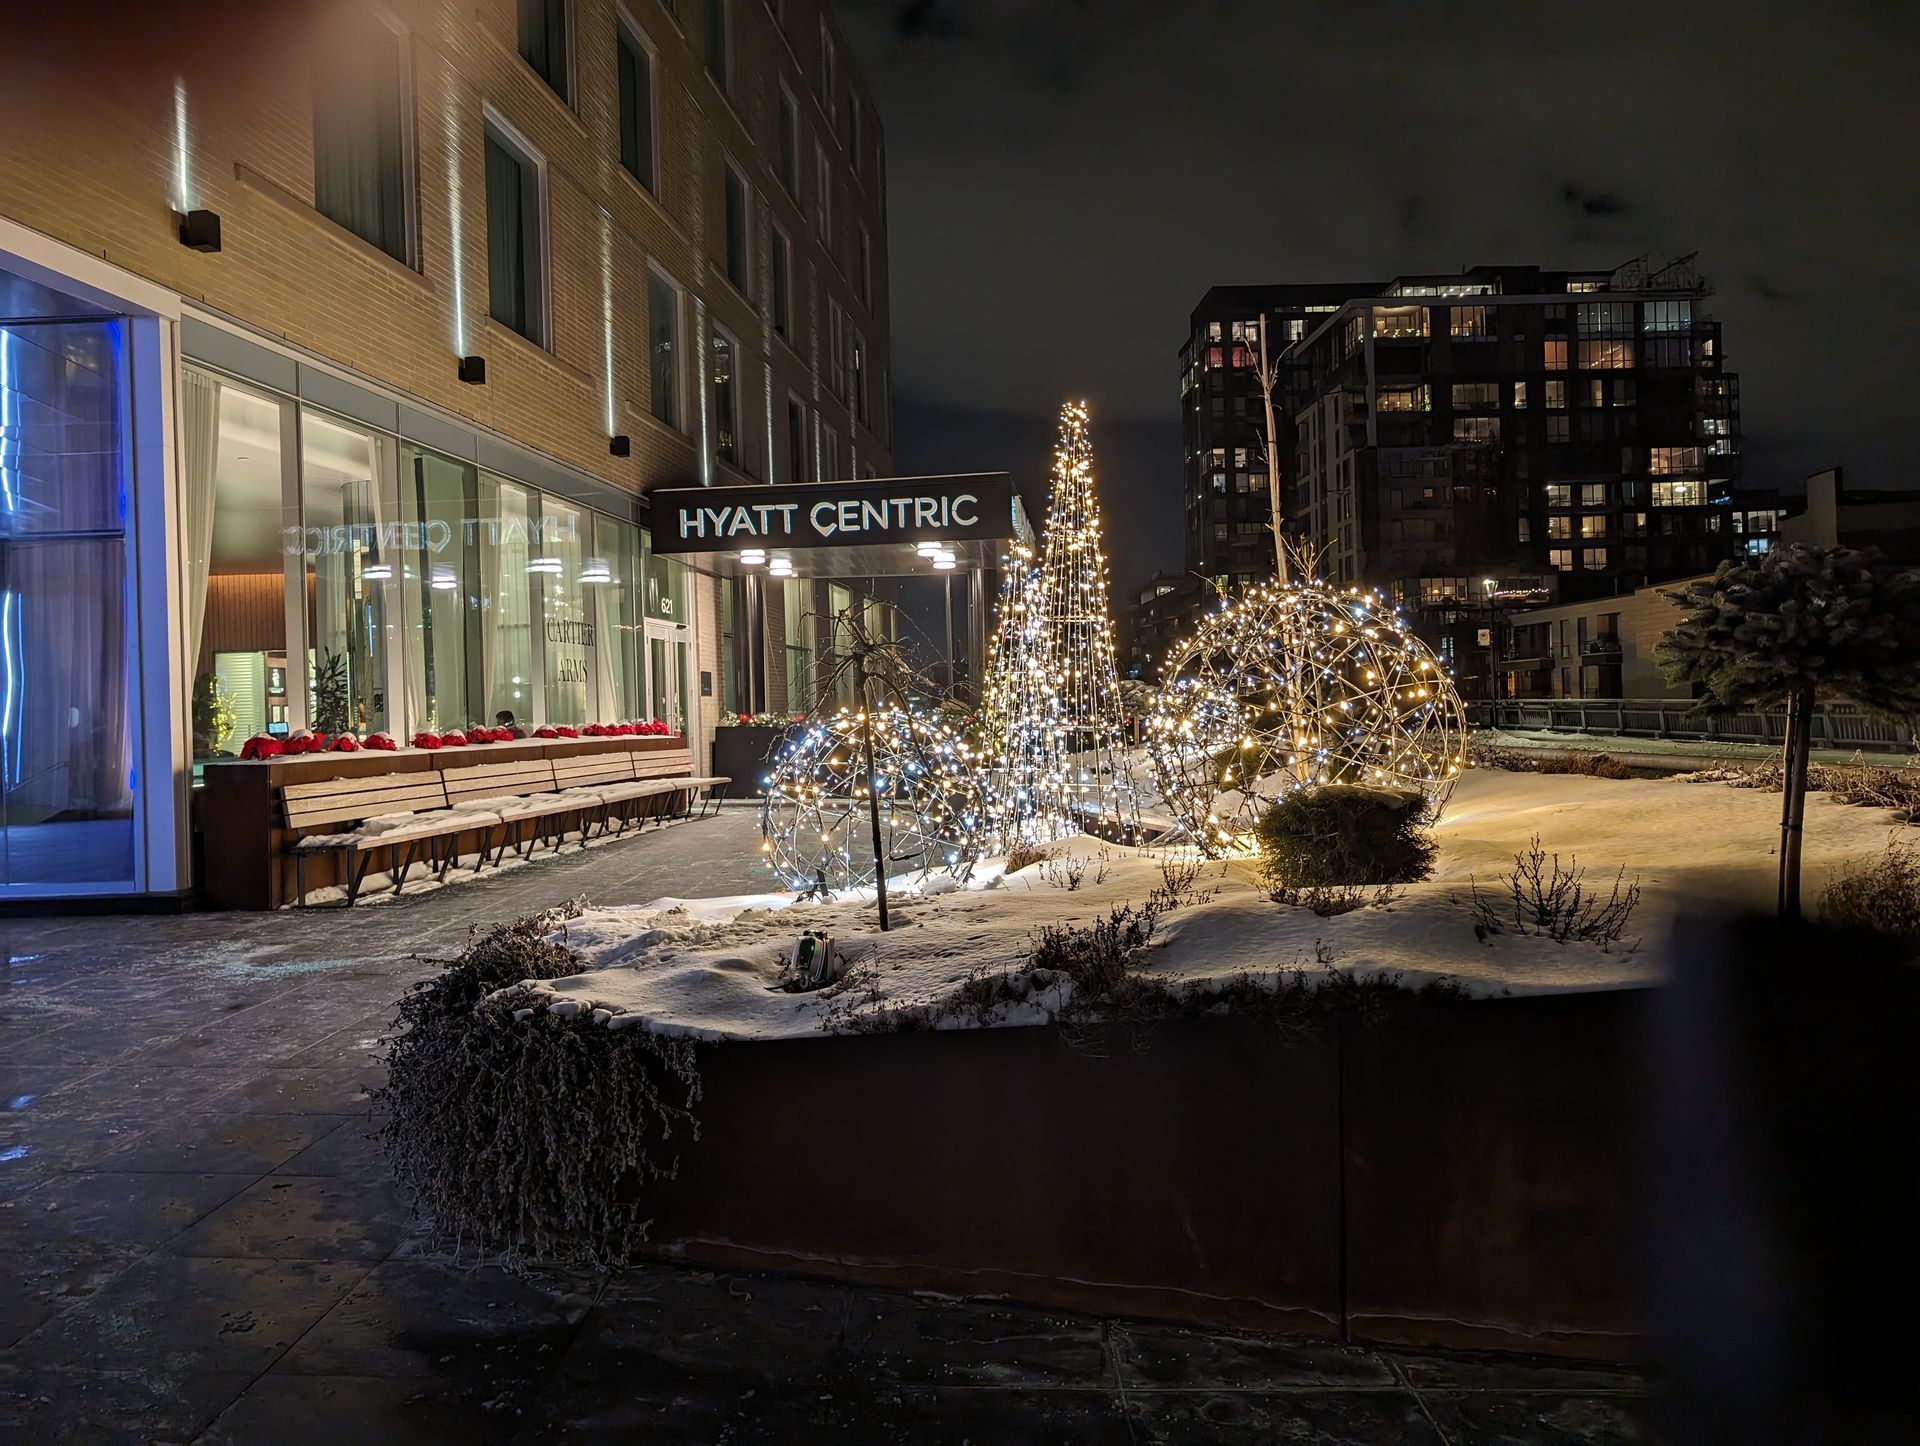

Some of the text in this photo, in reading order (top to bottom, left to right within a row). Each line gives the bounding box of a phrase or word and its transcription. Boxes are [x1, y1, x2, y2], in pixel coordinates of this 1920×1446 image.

[679, 503, 798, 538] HYATT
[811, 495, 977, 537] CENTRIC
[661, 597, 673, 615] 621
[547, 617, 594, 646] CARTIER
[558, 658, 588, 682] ARMS
